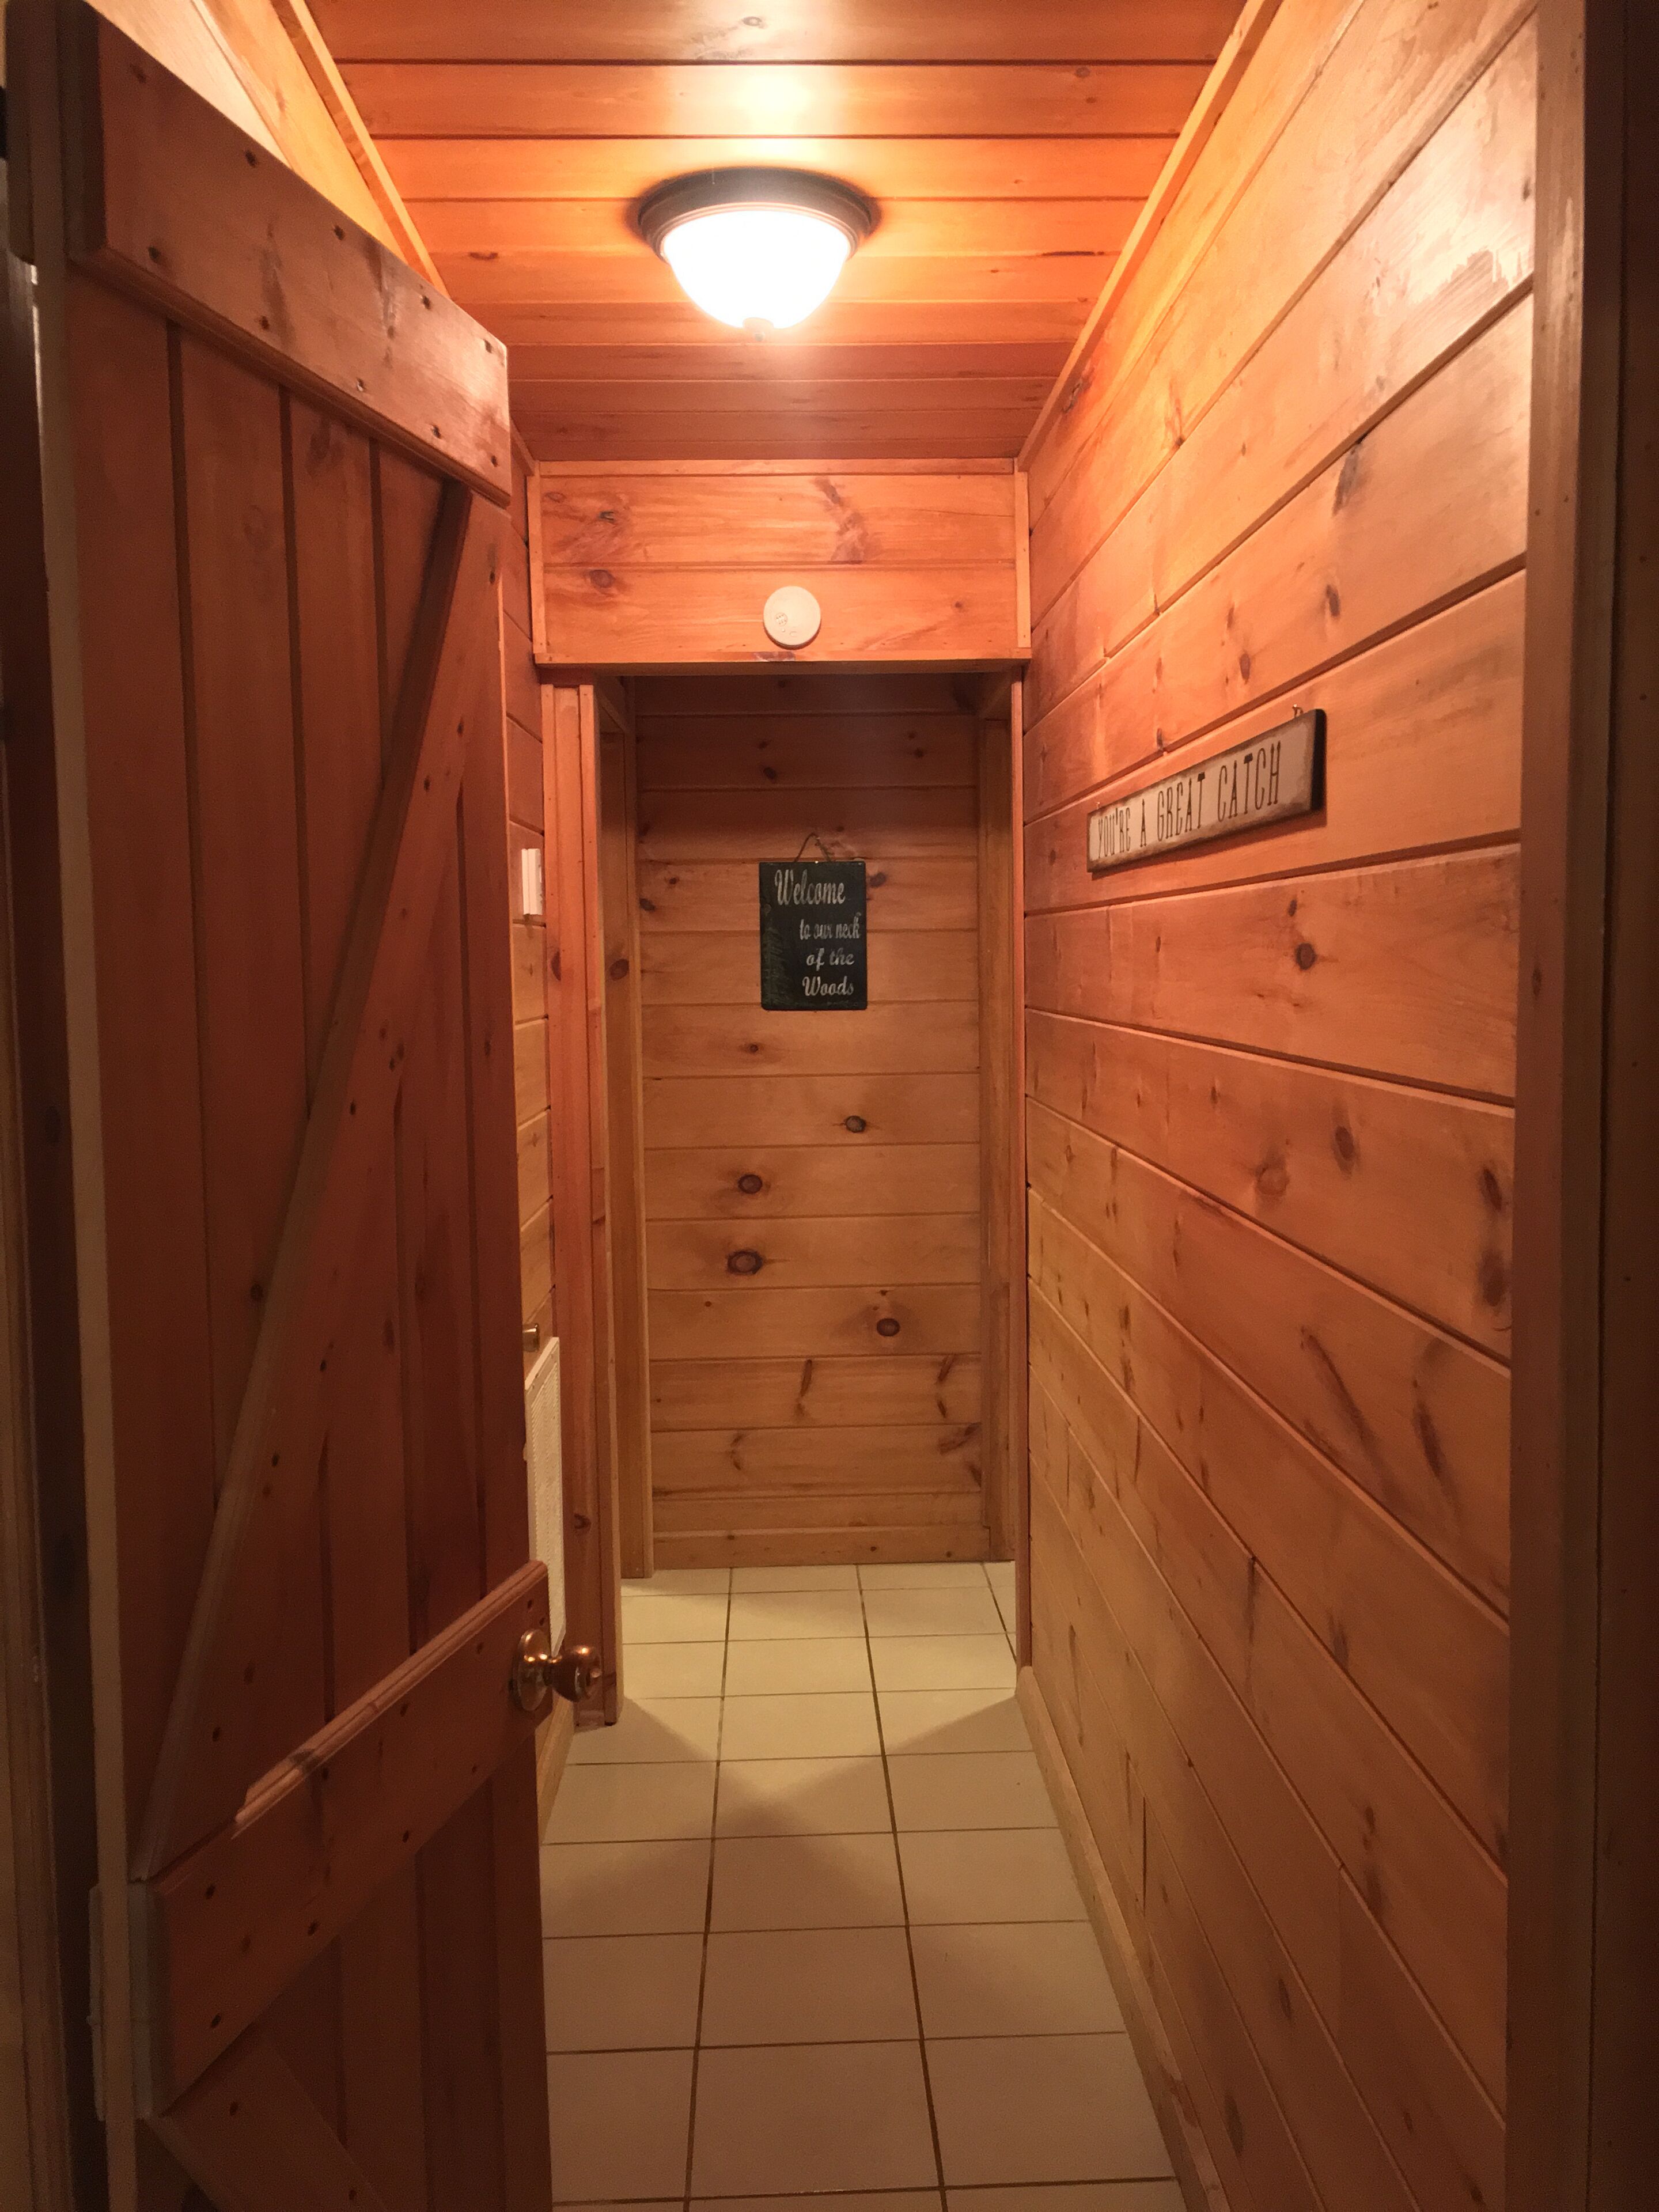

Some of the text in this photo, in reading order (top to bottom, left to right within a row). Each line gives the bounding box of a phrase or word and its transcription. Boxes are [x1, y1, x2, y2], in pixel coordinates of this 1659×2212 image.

[1098, 740, 1281, 858] YOU'RE A GREAT CATCH
[775, 869, 846, 906] Welcome
[800, 914, 861, 940] to our neck
[806, 948, 854, 971] of the
[802, 976, 854, 996] Woods
